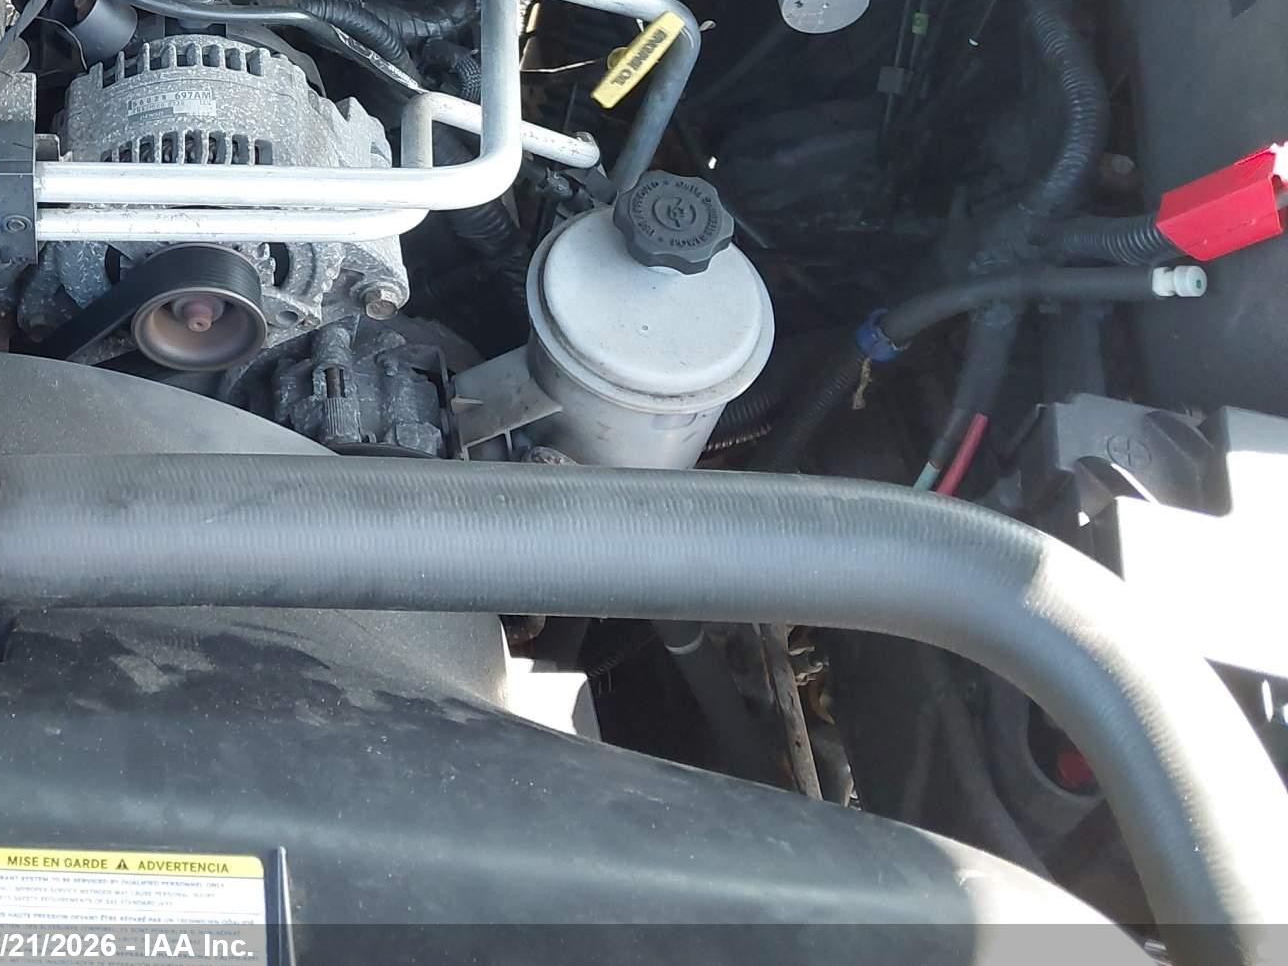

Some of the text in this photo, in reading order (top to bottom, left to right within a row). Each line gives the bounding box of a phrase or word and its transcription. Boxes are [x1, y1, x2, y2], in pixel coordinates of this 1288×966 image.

[611, 28, 668, 86] ENGINE OIL
[174, 91, 211, 100] 697AM
[7, 855, 39, 867] MISE
[43, 857, 60, 868] EN
[63, 858, 108, 869] GARDE
[137, 860, 229, 874] ADVERTENCIA
